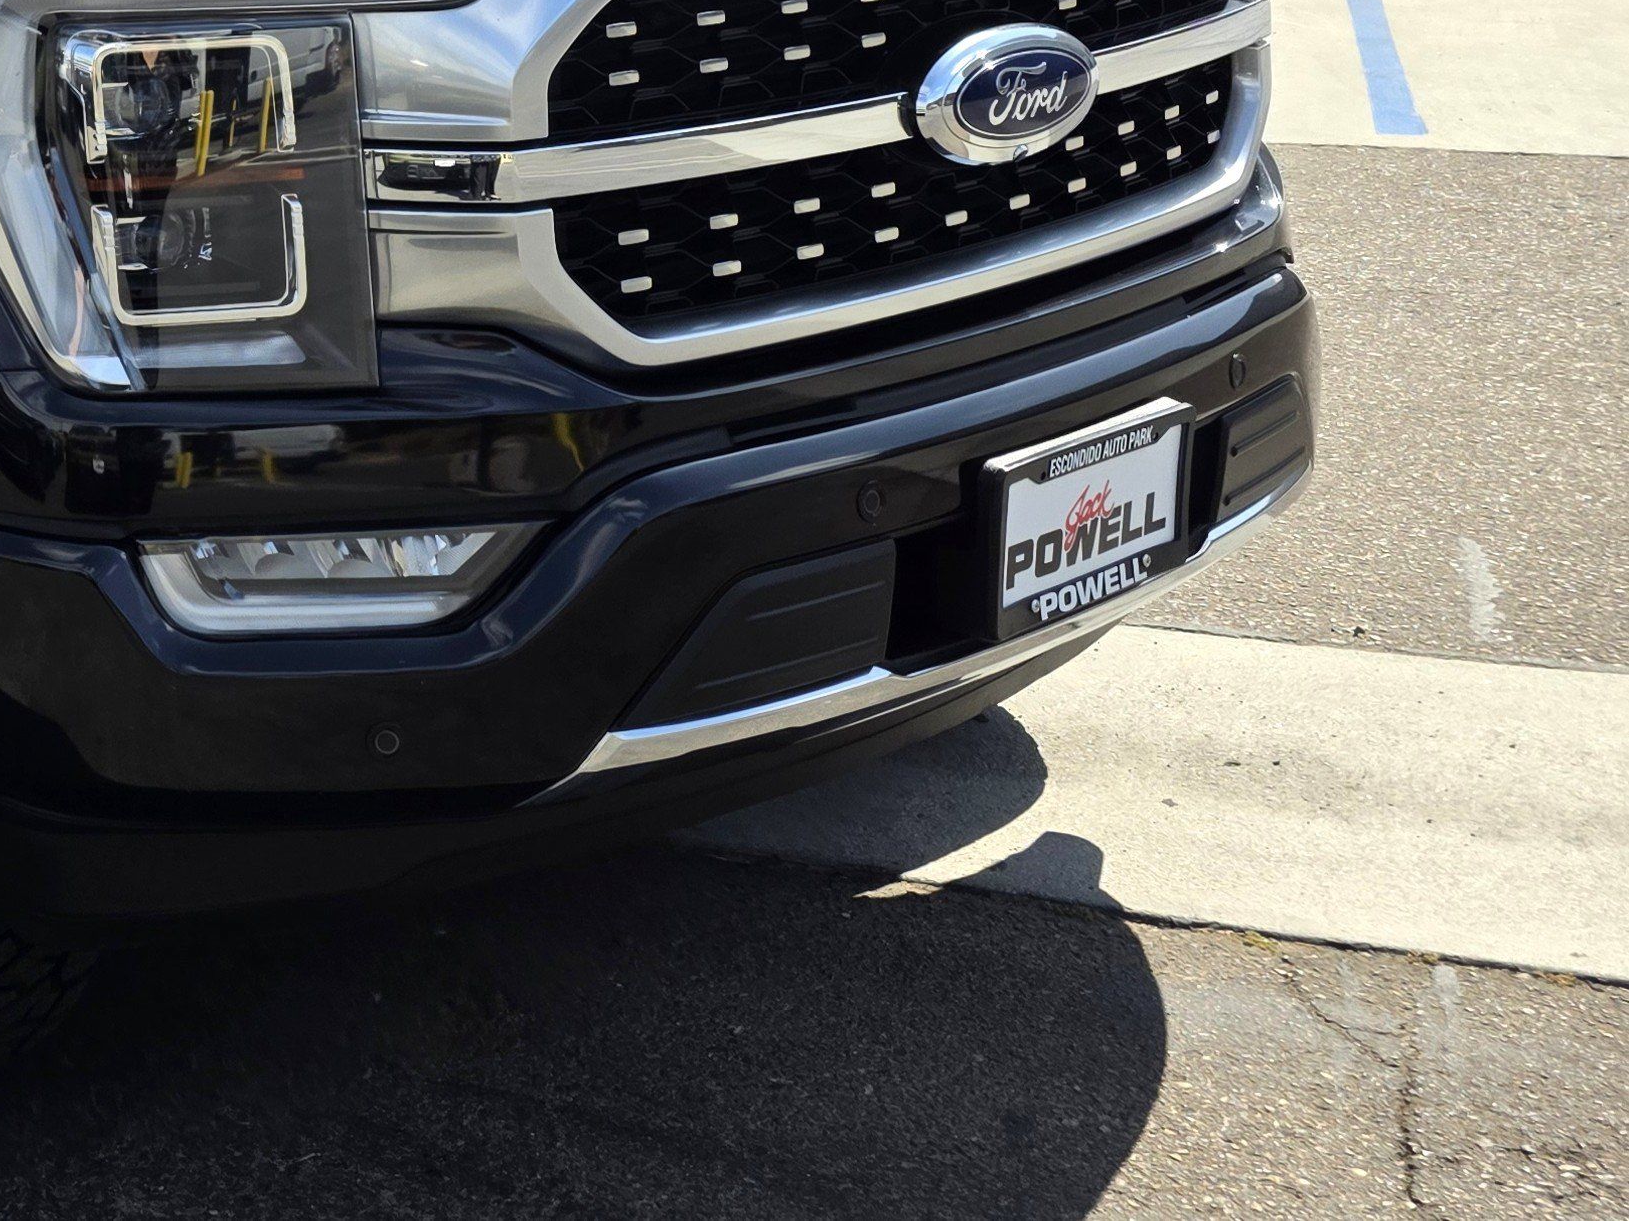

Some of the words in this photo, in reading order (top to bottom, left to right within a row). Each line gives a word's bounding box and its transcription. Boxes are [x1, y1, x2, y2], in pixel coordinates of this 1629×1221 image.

[989, 61, 1068, 126] Ford
[1049, 446, 1102, 478] ESCONDIDO
[1102, 433, 1128, 458] AUTO
[1127, 425, 1154, 450] PARK
[1006, 491, 1167, 590] POWELL
[1064, 479, 1115, 551] Jack
[1039, 558, 1148, 621] POWELL
